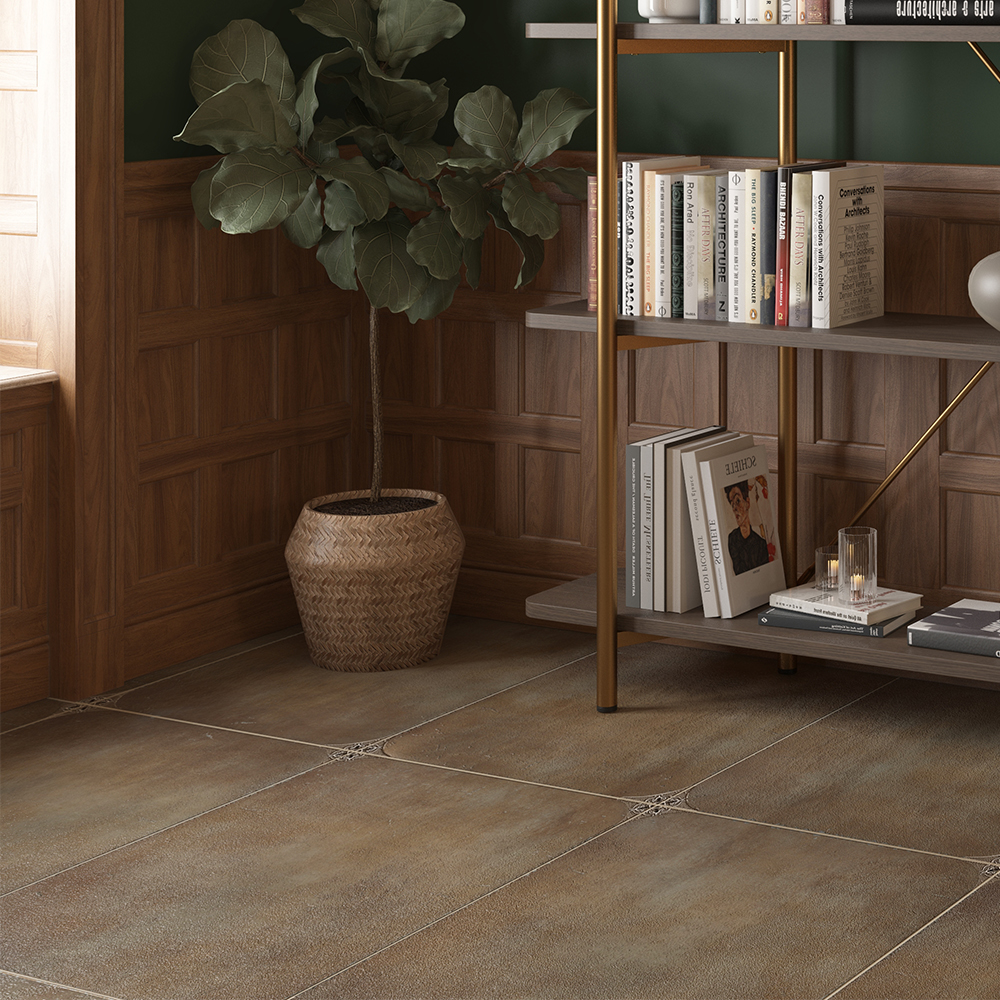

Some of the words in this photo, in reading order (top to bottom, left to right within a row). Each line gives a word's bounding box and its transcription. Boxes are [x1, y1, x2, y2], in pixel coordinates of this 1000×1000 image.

[896, 0, 957, 20] architecture
[974, 0, 994, 19] arts
[686, 182, 694, 199] Ron
[839, 185, 875, 197] Conversations
[852, 197, 863, 205] with
[686, 202, 694, 223] Arad
[702, 208, 710, 236] AFTER
[844, 206, 870, 218] Architects
[795, 208, 805, 238] AFTER
[718, 185, 726, 283] ARCHITECTURE
[702, 239, 710, 262] DAYS
[794, 241, 803, 266] DAYS
